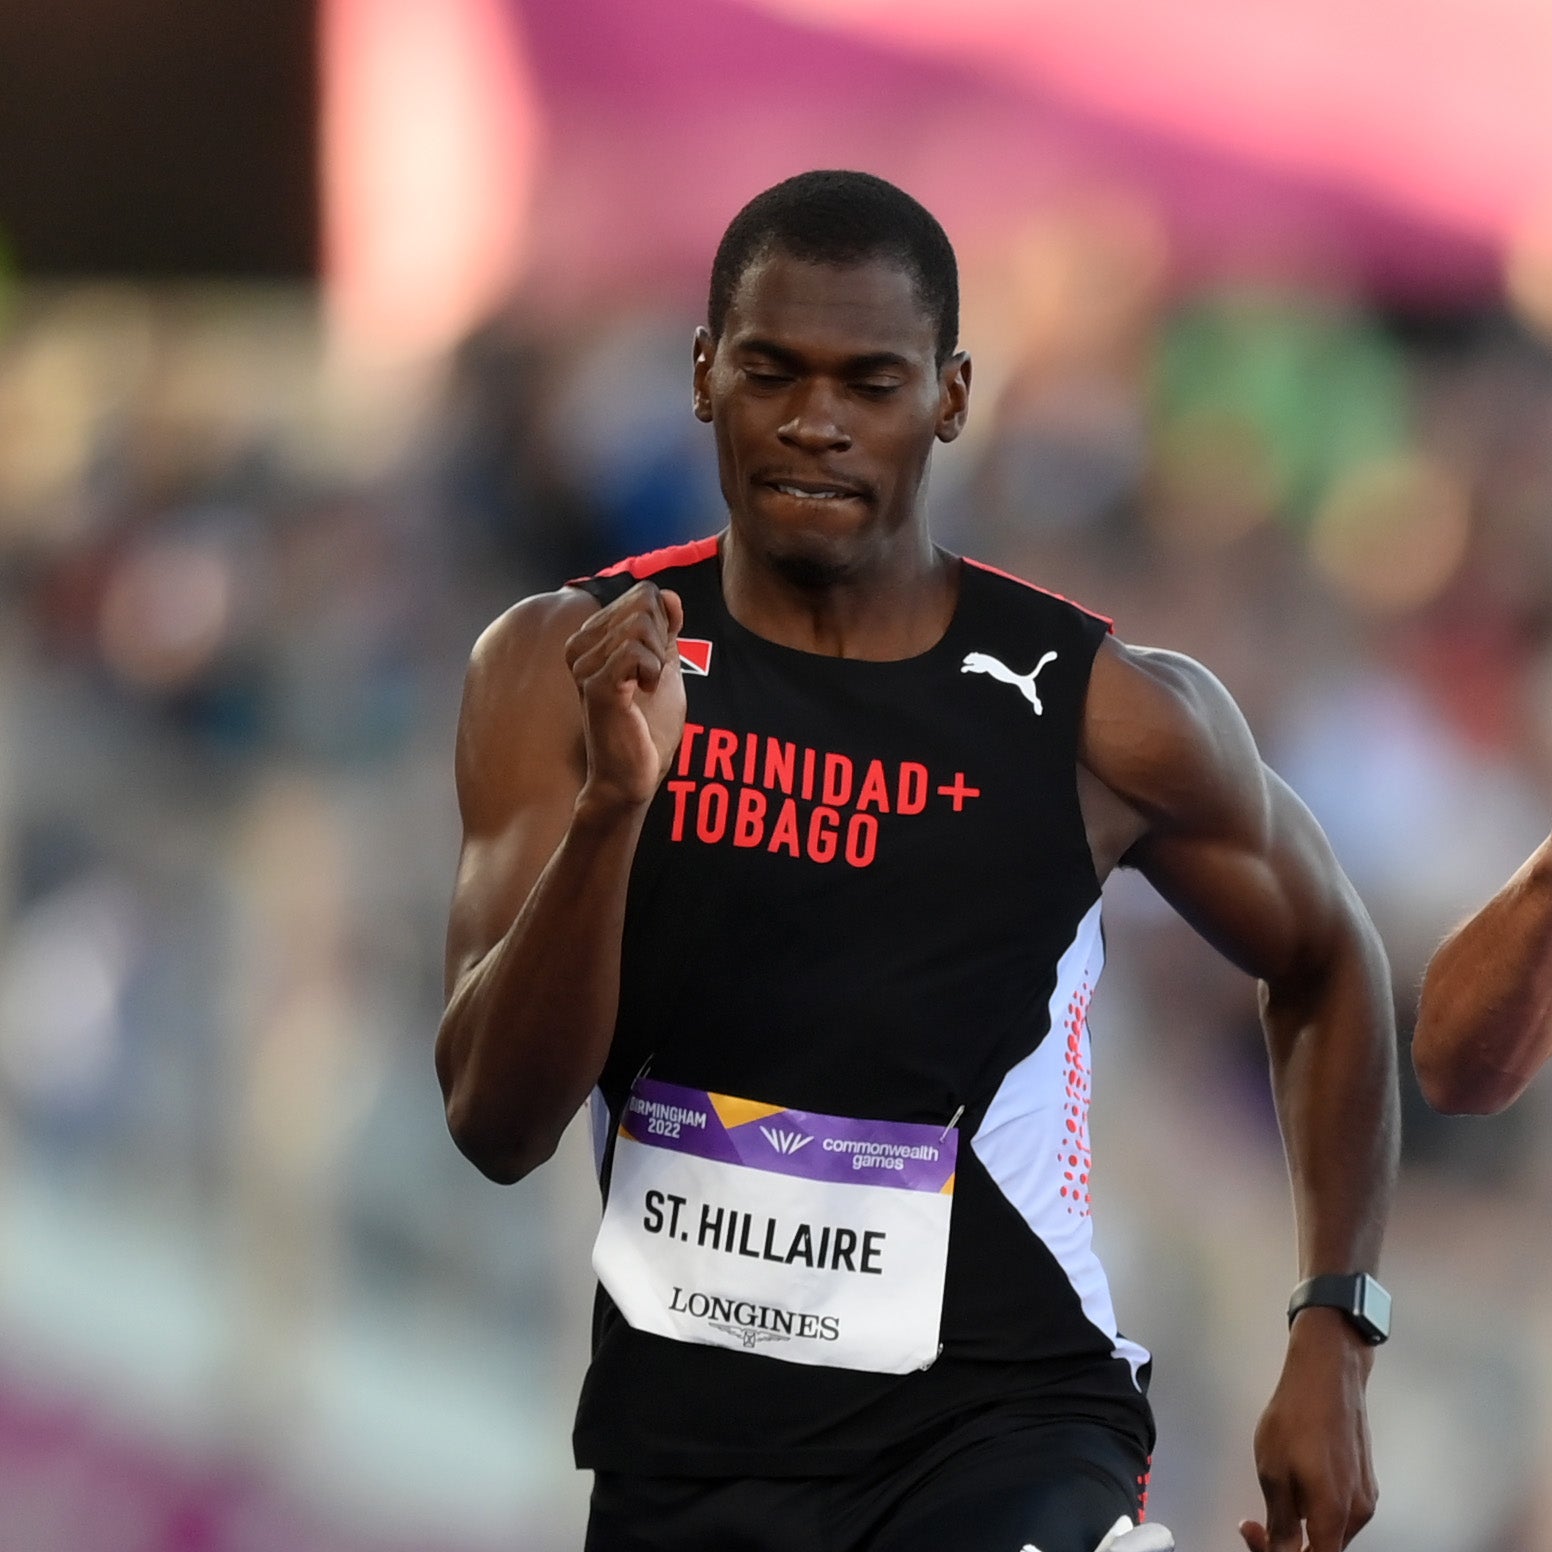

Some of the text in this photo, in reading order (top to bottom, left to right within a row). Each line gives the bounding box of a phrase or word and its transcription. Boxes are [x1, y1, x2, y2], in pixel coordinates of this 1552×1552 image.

[668, 780, 878, 868] TOBAGO
[629, 1096, 707, 1130] BIRMINGHAM
[647, 1117, 681, 1139] 2022
[822, 1137, 939, 1163] commonwealth
[852, 1153, 905, 1171] games
[642, 1189, 887, 1275] ST. HILLAIRE
[668, 1286, 841, 1342] LONGINES
